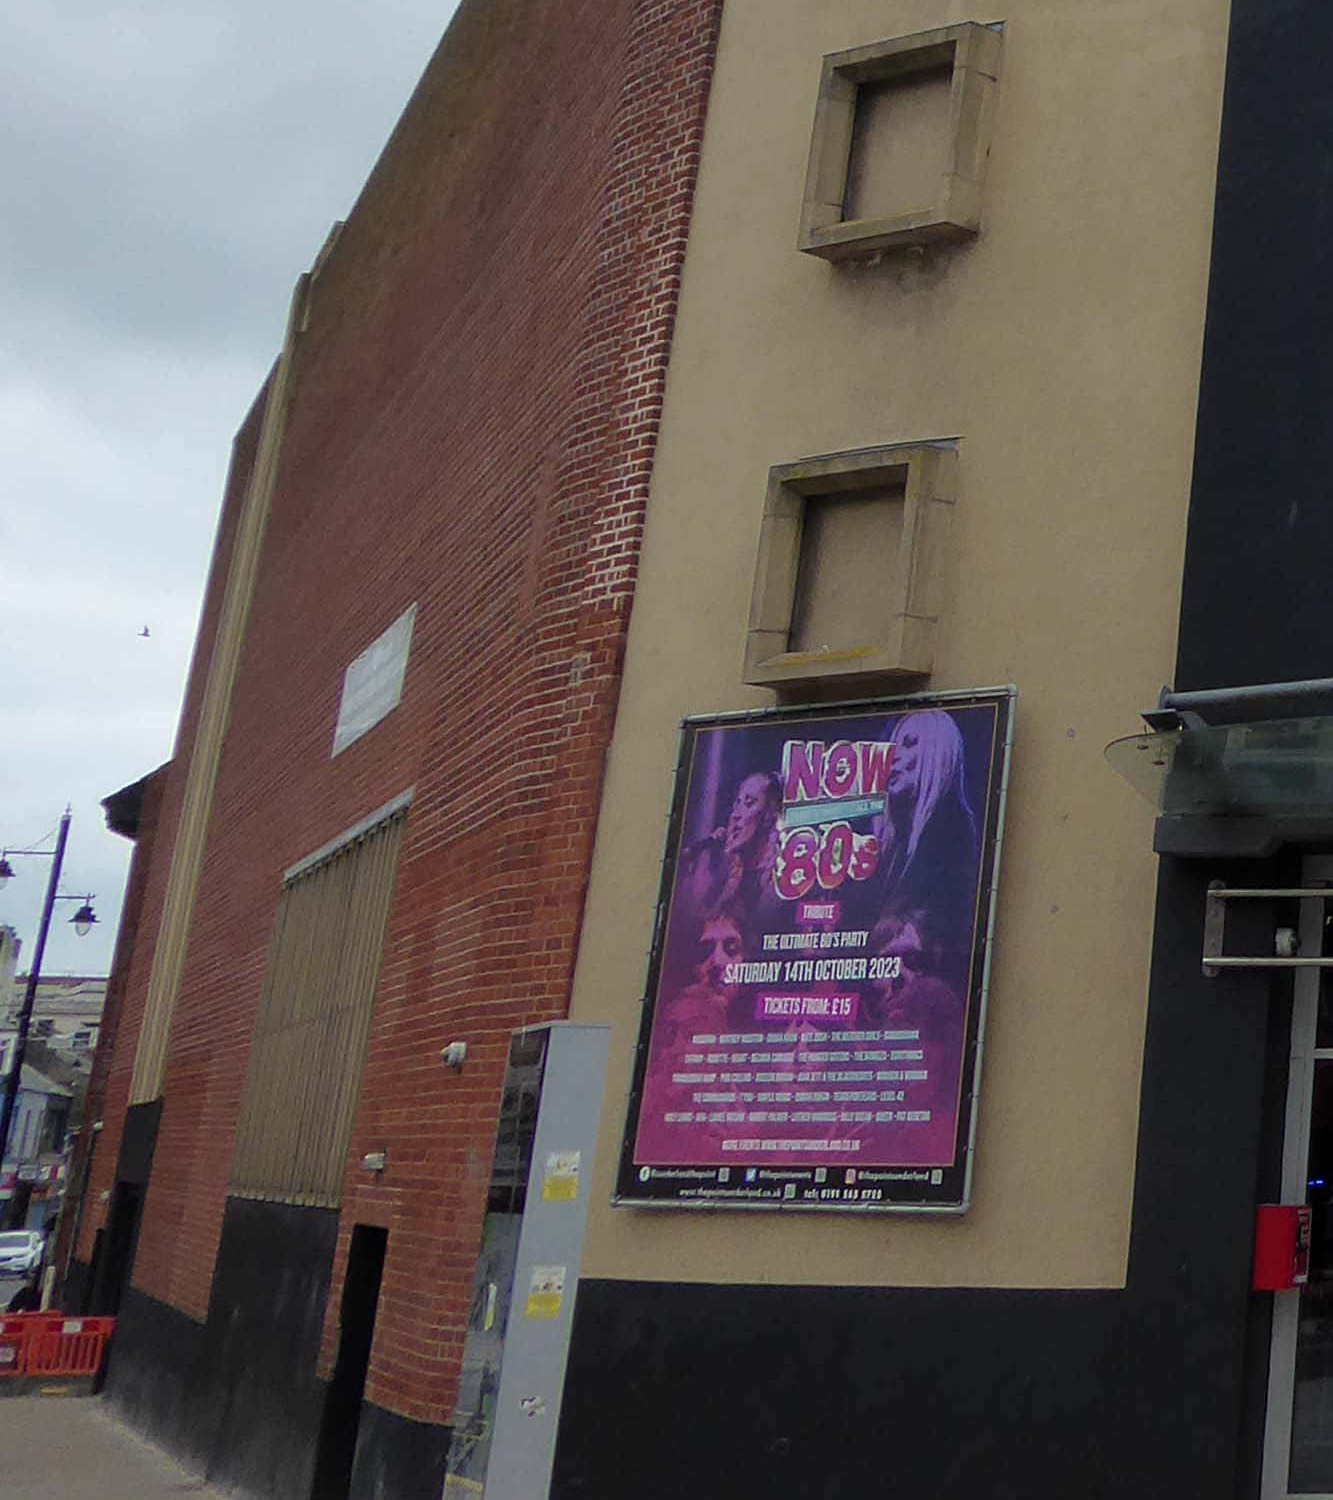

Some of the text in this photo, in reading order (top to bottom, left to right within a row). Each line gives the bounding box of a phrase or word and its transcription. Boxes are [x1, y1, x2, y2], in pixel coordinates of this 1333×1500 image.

[782, 739, 897, 803] NOW
[773, 820, 880, 900] 80s
[763, 933, 780, 950] THE
[841, 930, 869, 947] PARTY
[724, 956, 901, 985] SATURDAY 14TH OCTOBER 2023
[764, 997, 801, 1015] TICKETS
[831, 996, 852, 1015] £15
